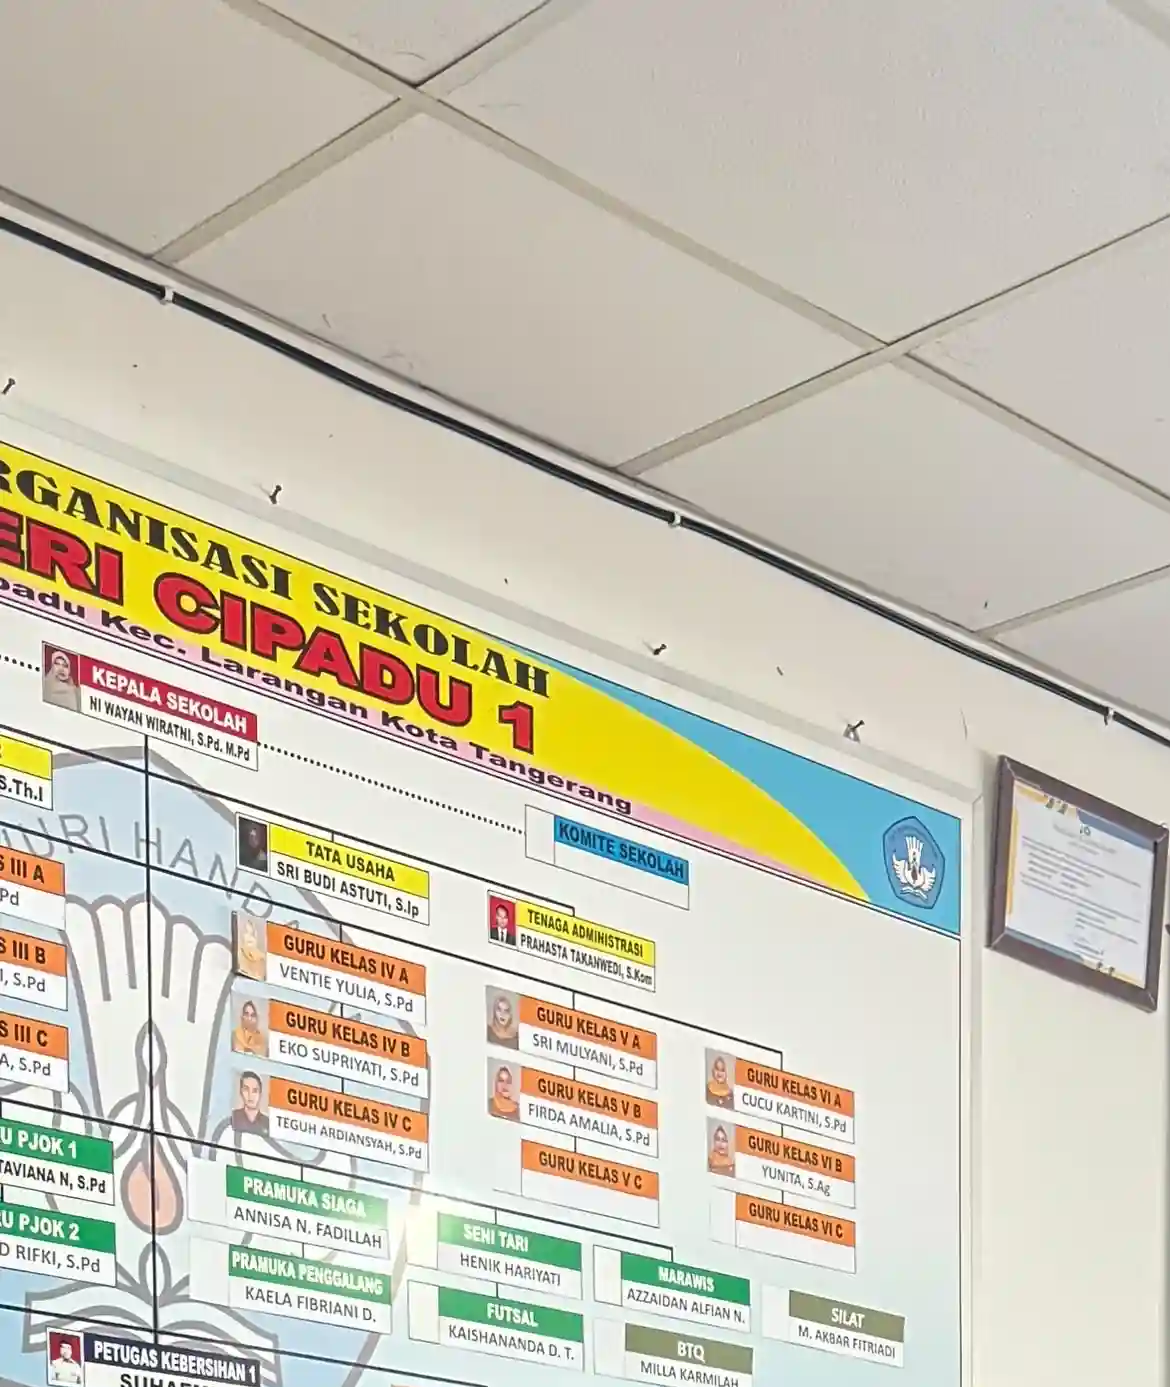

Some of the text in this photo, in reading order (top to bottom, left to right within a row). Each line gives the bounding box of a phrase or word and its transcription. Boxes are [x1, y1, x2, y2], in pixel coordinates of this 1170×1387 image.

[313, 582, 550, 698] SEKOLAH
[153, 571, 473, 728] CIPADU
[498, 700, 535, 755] 1
[90, 695, 101, 713] NI
[104, 699, 143, 728] WAYAN
[92, 665, 248, 735] KEPALA SEKOLAH
[102, 610, 186, 655] Kec.
[202, 646, 368, 720] Larangan
[381, 711, 457, 751] Kota
[469, 742, 632, 815] Tangerang
[306, 840, 395, 882] TATA USAHA
[559, 823, 684, 879] KOMITE SEKOLAH
[277, 861, 299, 881] SRI
[304, 869, 335, 892] BUDI
[340, 881, 391, 911] ASTUTI,
[527, 909, 643, 957] TENAGA ADMINISTRASI
[284, 935, 409, 985] GURU KELAS IV A
[13, 972, 45, 992] S.Pd
[280, 963, 413, 1012] VENTIE YULIA, S.Pd
[286, 1011, 410, 1058] GURU KELAS IV B
[533, 1033, 643, 1076] SRI MULYANI, S.Pd
[19, 1057, 50, 1076] S.Pd
[279, 1039, 419, 1087] EKO SUPRIYATI, S.Pd
[287, 1088, 412, 1133] GURU KELAS IV C
[528, 1103, 650, 1146] FIRDA AMALIA, S.Pd
[742, 1093, 846, 1133] CUCU KARTINI, S.Pd
[18, 1130, 76, 1159] PJOK 1
[243, 1176, 367, 1218] PRAMUKA SIAGA
[19, 1213, 80, 1241] PJOK 2
[234, 1206, 382, 1249] ANNISA N. FADILLAH
[16, 1245, 100, 1273] RIFKI, S.Pd
[232, 1251, 383, 1295] PRAMUKA PENGGALANG
[460, 1252, 561, 1286] HENIK HARIYATI
[245, 1285, 376, 1322] KAELA FIBRIANI D.
[487, 1302, 539, 1327] FUTSAL
[831, 1307, 865, 1328] SILAT
[93, 1340, 257, 1384] PETUGAS KEBERSIHAN 1
[640, 1359, 676, 1378] MILLA
[677, 1341, 705, 1363] BTQ
